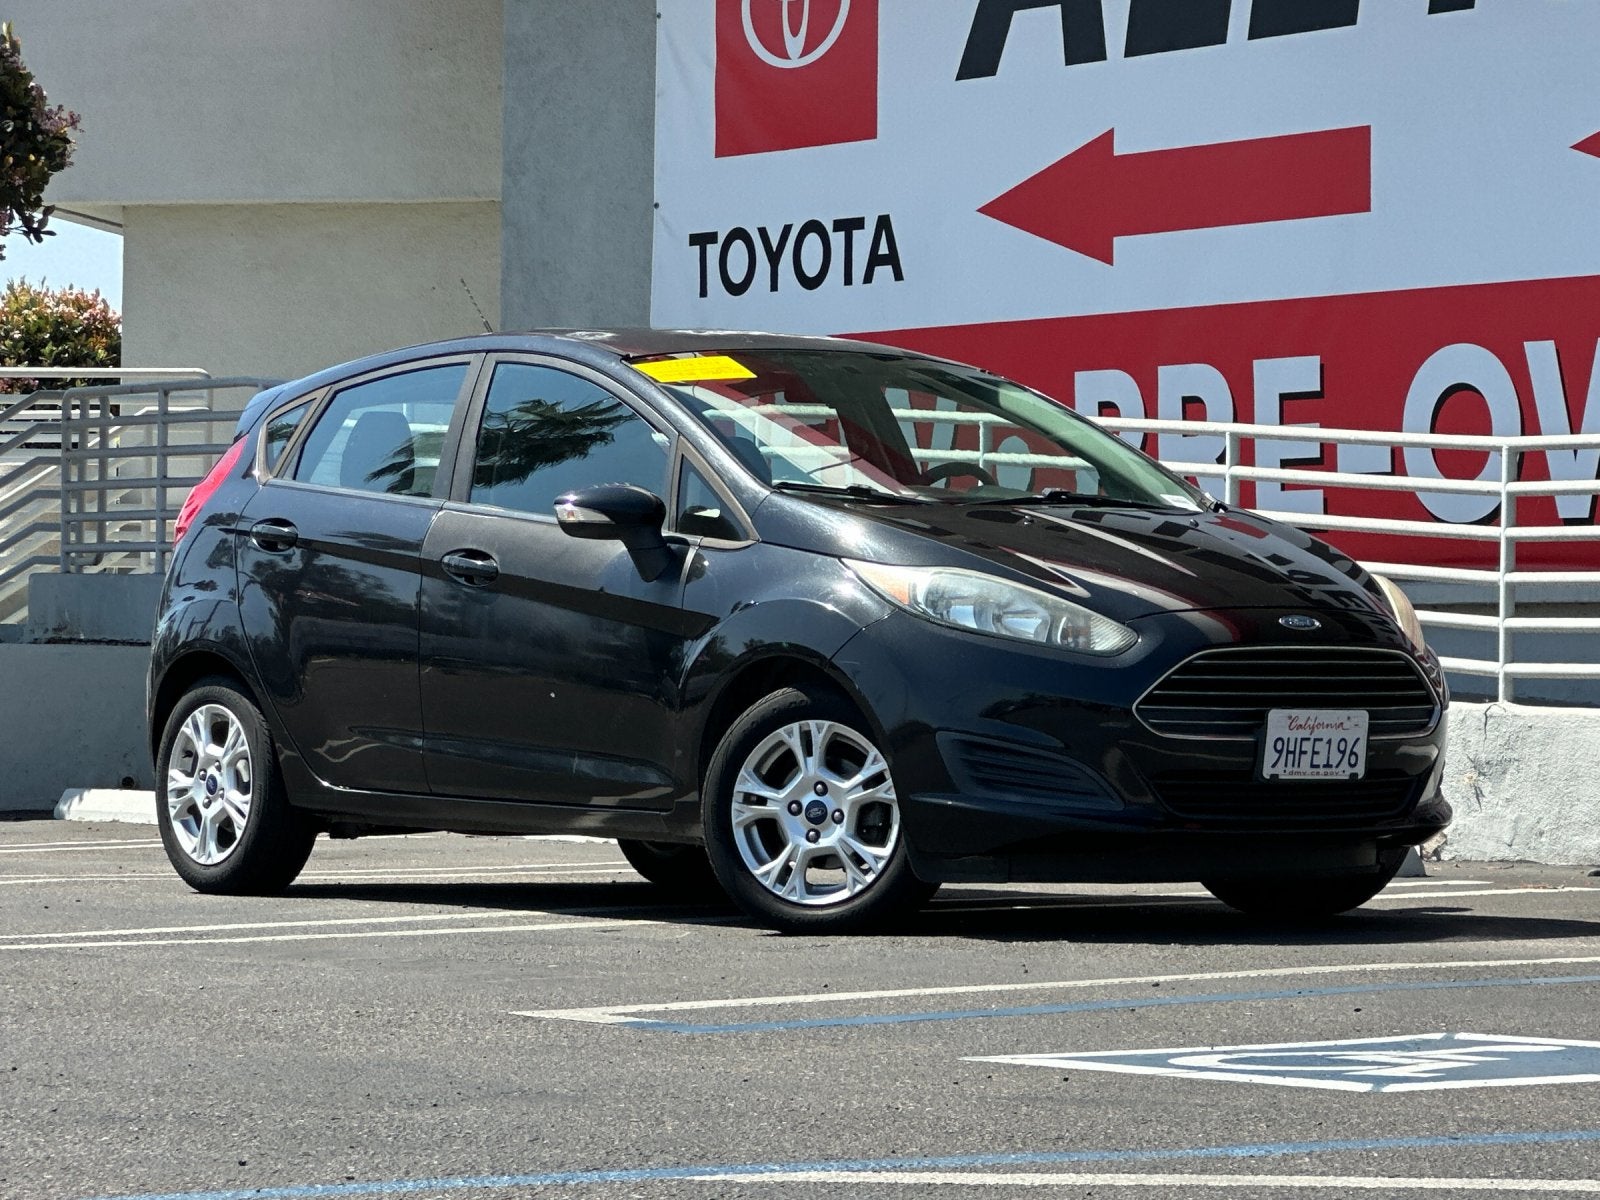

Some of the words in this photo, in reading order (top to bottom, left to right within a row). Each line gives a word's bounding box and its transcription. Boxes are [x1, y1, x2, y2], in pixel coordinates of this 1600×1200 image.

[689, 214, 904, 298] TOYOTA
[1288, 716, 1349, 736] California
[1270, 736, 1360, 769] 9HFE196
